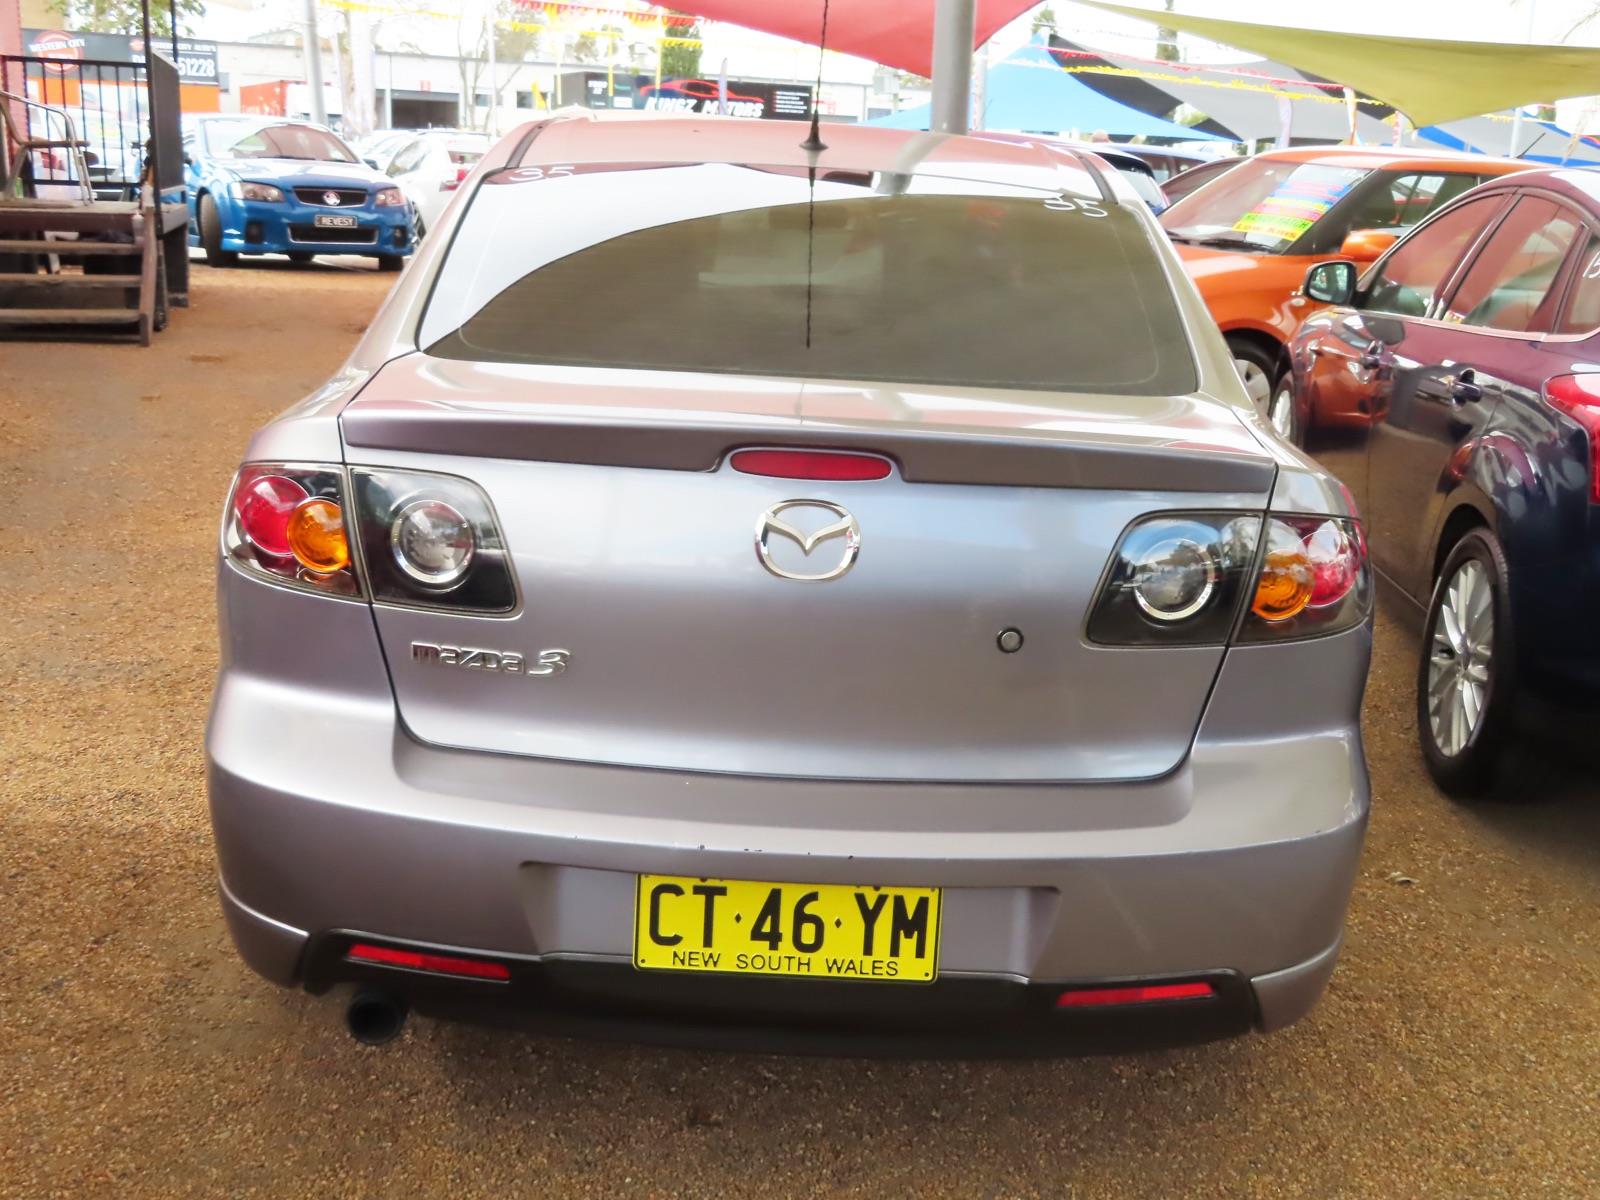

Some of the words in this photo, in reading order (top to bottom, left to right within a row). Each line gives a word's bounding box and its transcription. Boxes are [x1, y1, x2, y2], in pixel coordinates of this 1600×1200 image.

[701, 99, 765, 118] MTORS
[1044, 196, 1108, 217] 35
[671, 950, 722, 968] NEW
[735, 953, 811, 972] SOUTH
[825, 957, 899, 976] WALES
